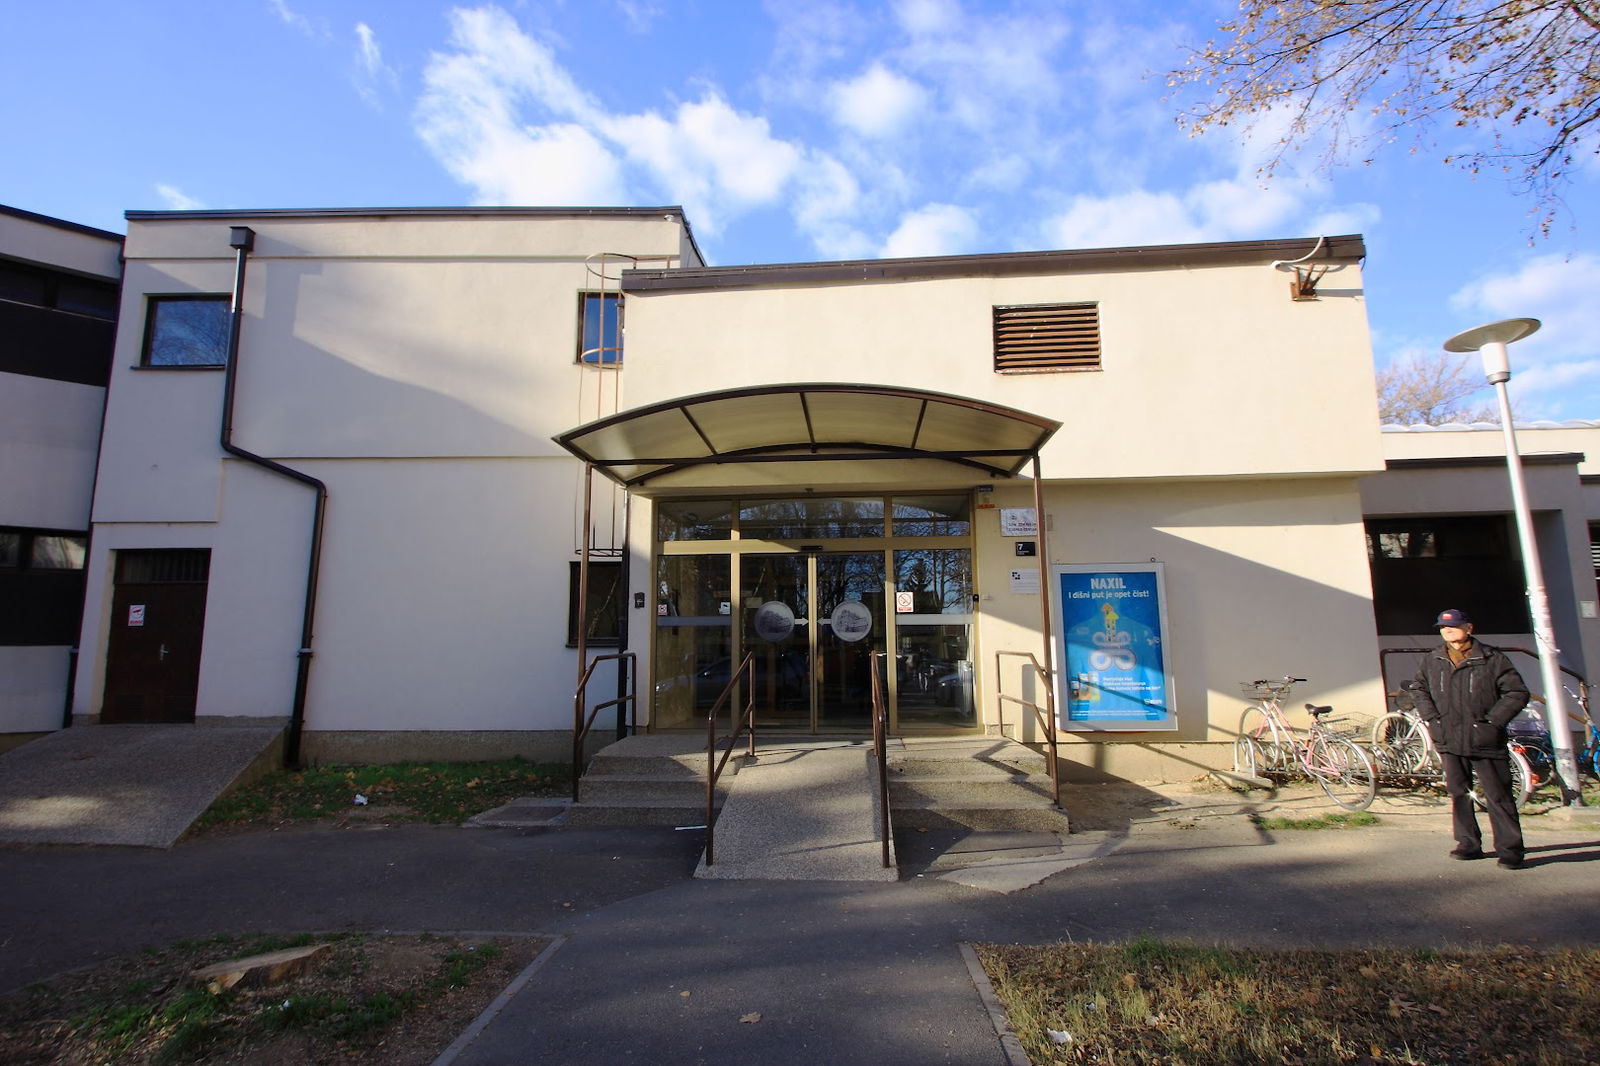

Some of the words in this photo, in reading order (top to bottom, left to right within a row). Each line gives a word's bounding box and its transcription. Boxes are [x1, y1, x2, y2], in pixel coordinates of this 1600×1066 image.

[1091, 577, 1126, 589] NAXIL
[1072, 590, 1090, 599] dišni
[1105, 591, 1113, 599] je
[1114, 591, 1131, 599] opet
[1132, 589, 1149, 598] čist!
